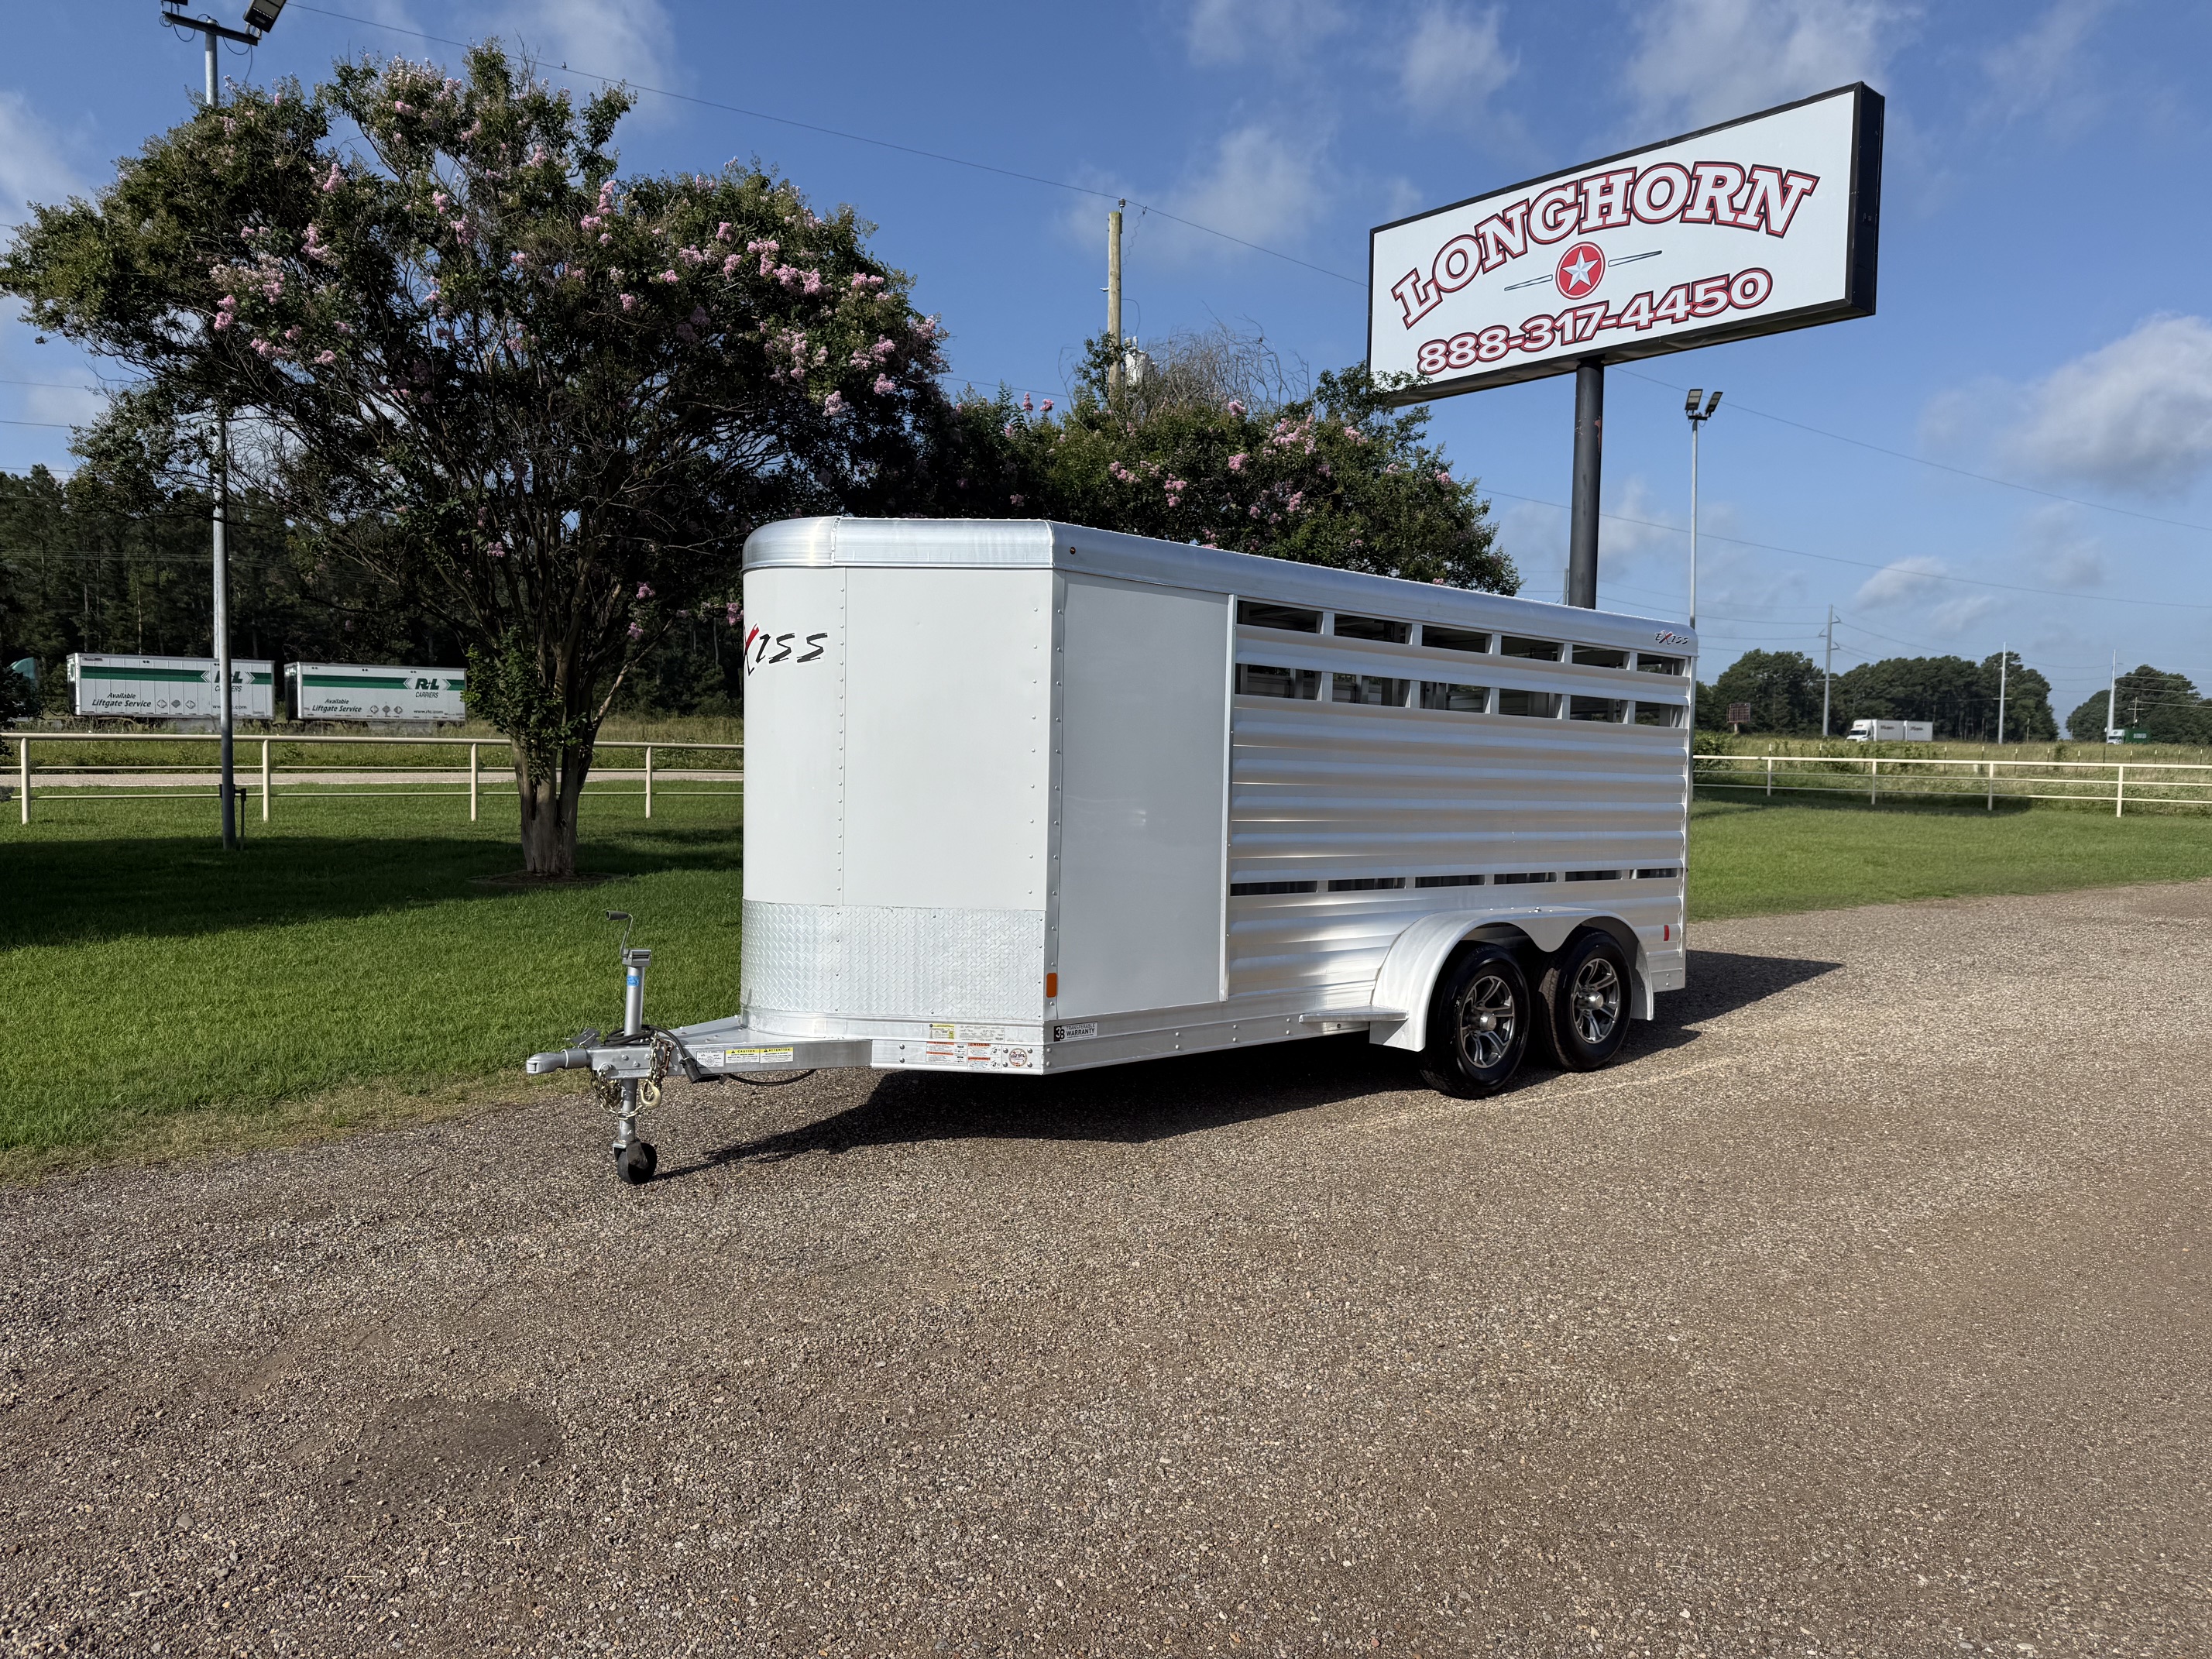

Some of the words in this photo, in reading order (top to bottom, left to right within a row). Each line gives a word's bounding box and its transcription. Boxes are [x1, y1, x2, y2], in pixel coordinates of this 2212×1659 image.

[1392, 161, 1820, 328] LONGHORN
[1417, 267, 1772, 375] 888-317-4450
[92, 699, 122, 709] Liftgate
[124, 699, 152, 708] Service
[311, 705, 337, 713] Liftgate
[1066, 1028, 1095, 1036] WARRANTY
